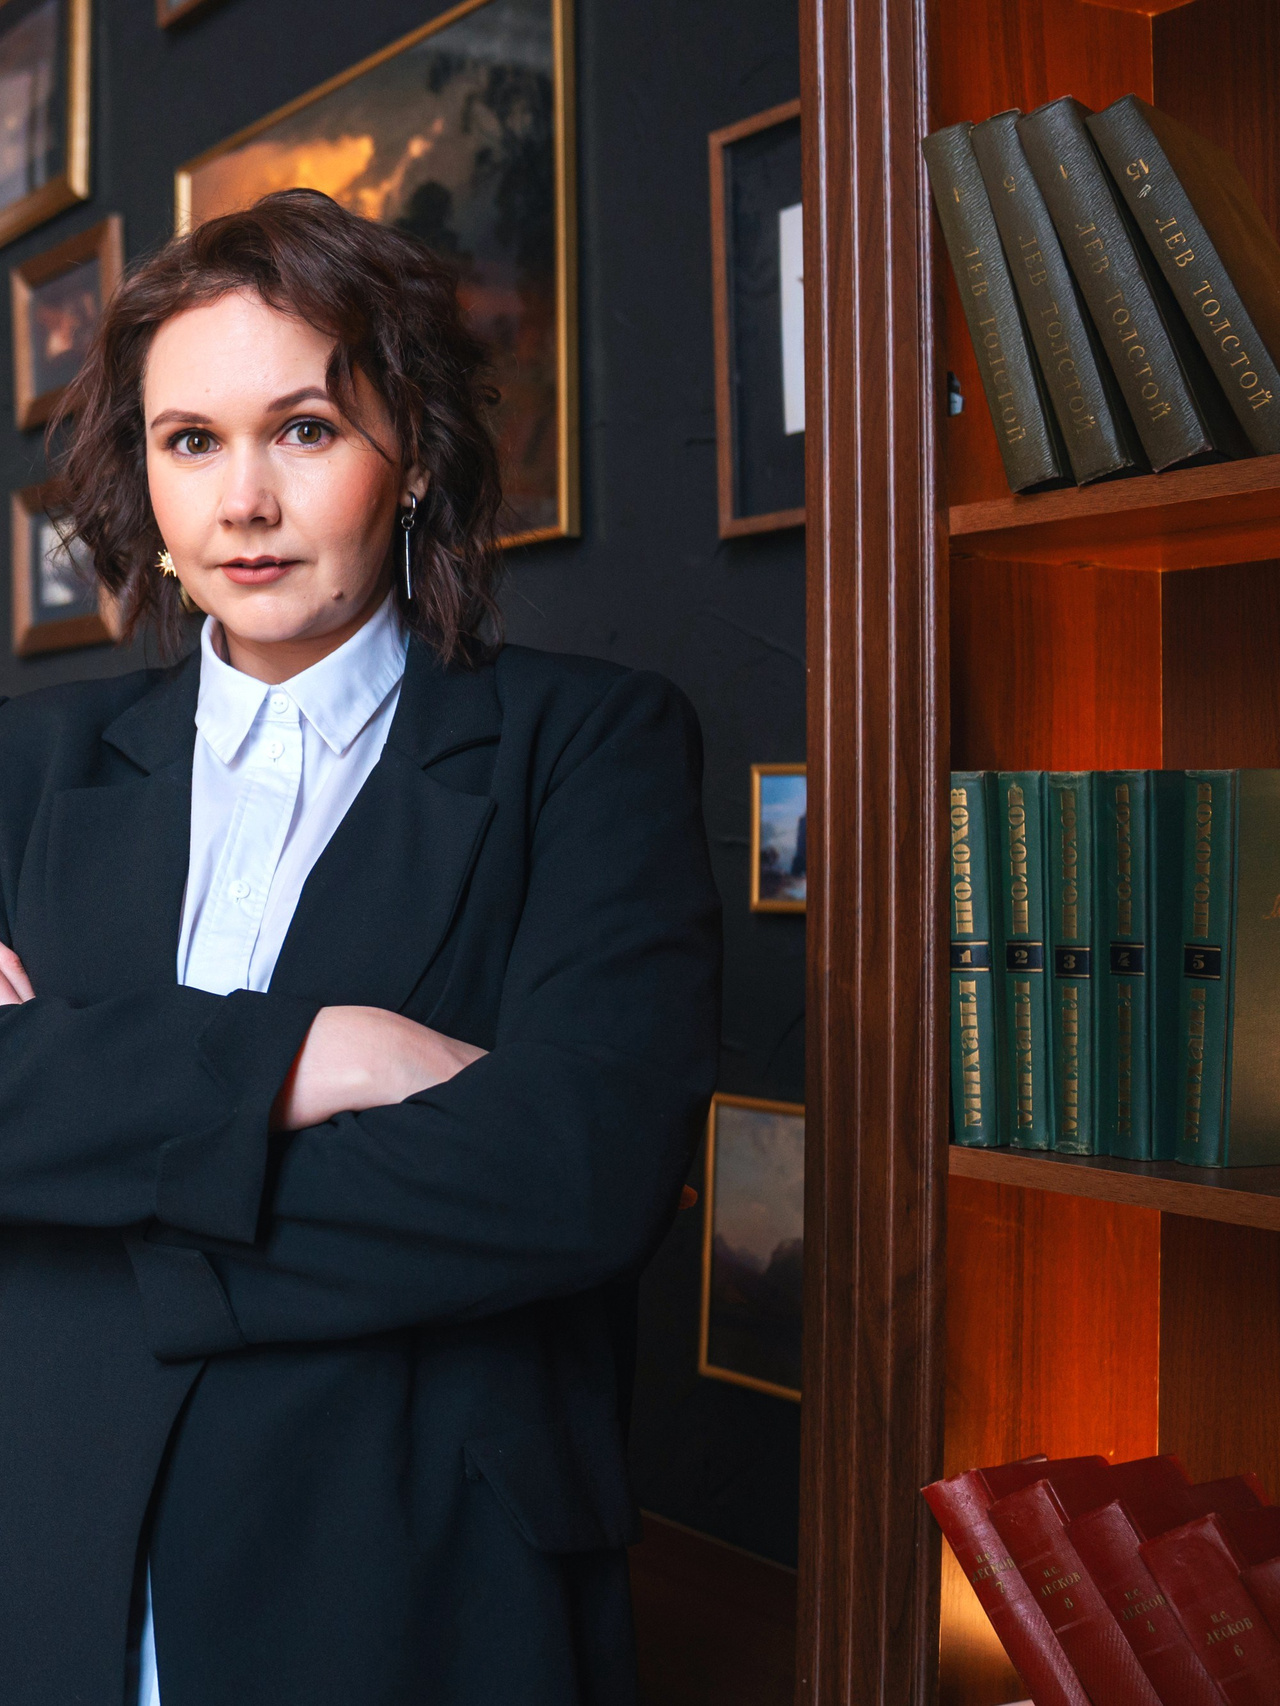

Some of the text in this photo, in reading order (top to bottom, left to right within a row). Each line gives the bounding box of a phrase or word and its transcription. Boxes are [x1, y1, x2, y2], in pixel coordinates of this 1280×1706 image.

[1127, 158, 1149, 181] 15
[1003, 175, 1017, 194] 5
[1075, 221, 1172, 423] ЛЕВ ТОЛСТОЙ
[1155, 216, 1273, 412] ЛЕВ ТОЛСТОЙ
[961, 245, 1028, 445] ЛЕВ ТОЛСТОЙ
[1018, 235, 1097, 435] ЛЕВ ТОЛСТОЙ
[959, 950, 973, 964] 1
[1015, 950, 1029, 964] 2
[1063, 954, 1076, 969] 3
[1117, 951, 1131, 968] 4
[1192, 954, 1205, 970] 5
[972, 1557, 1015, 1583] ЛЕСКОВ
[995, 1581, 1005, 1593] 7
[1041, 1571, 1082, 1597] ЛЕСКОВ
[1064, 1597, 1074, 1609] 8
[1122, 1594, 1167, 1621] ЛЕСКОВ
[1206, 1617, 1253, 1645] ЛЕСКОВ
[1233, 1644, 1244, 1657] 6
